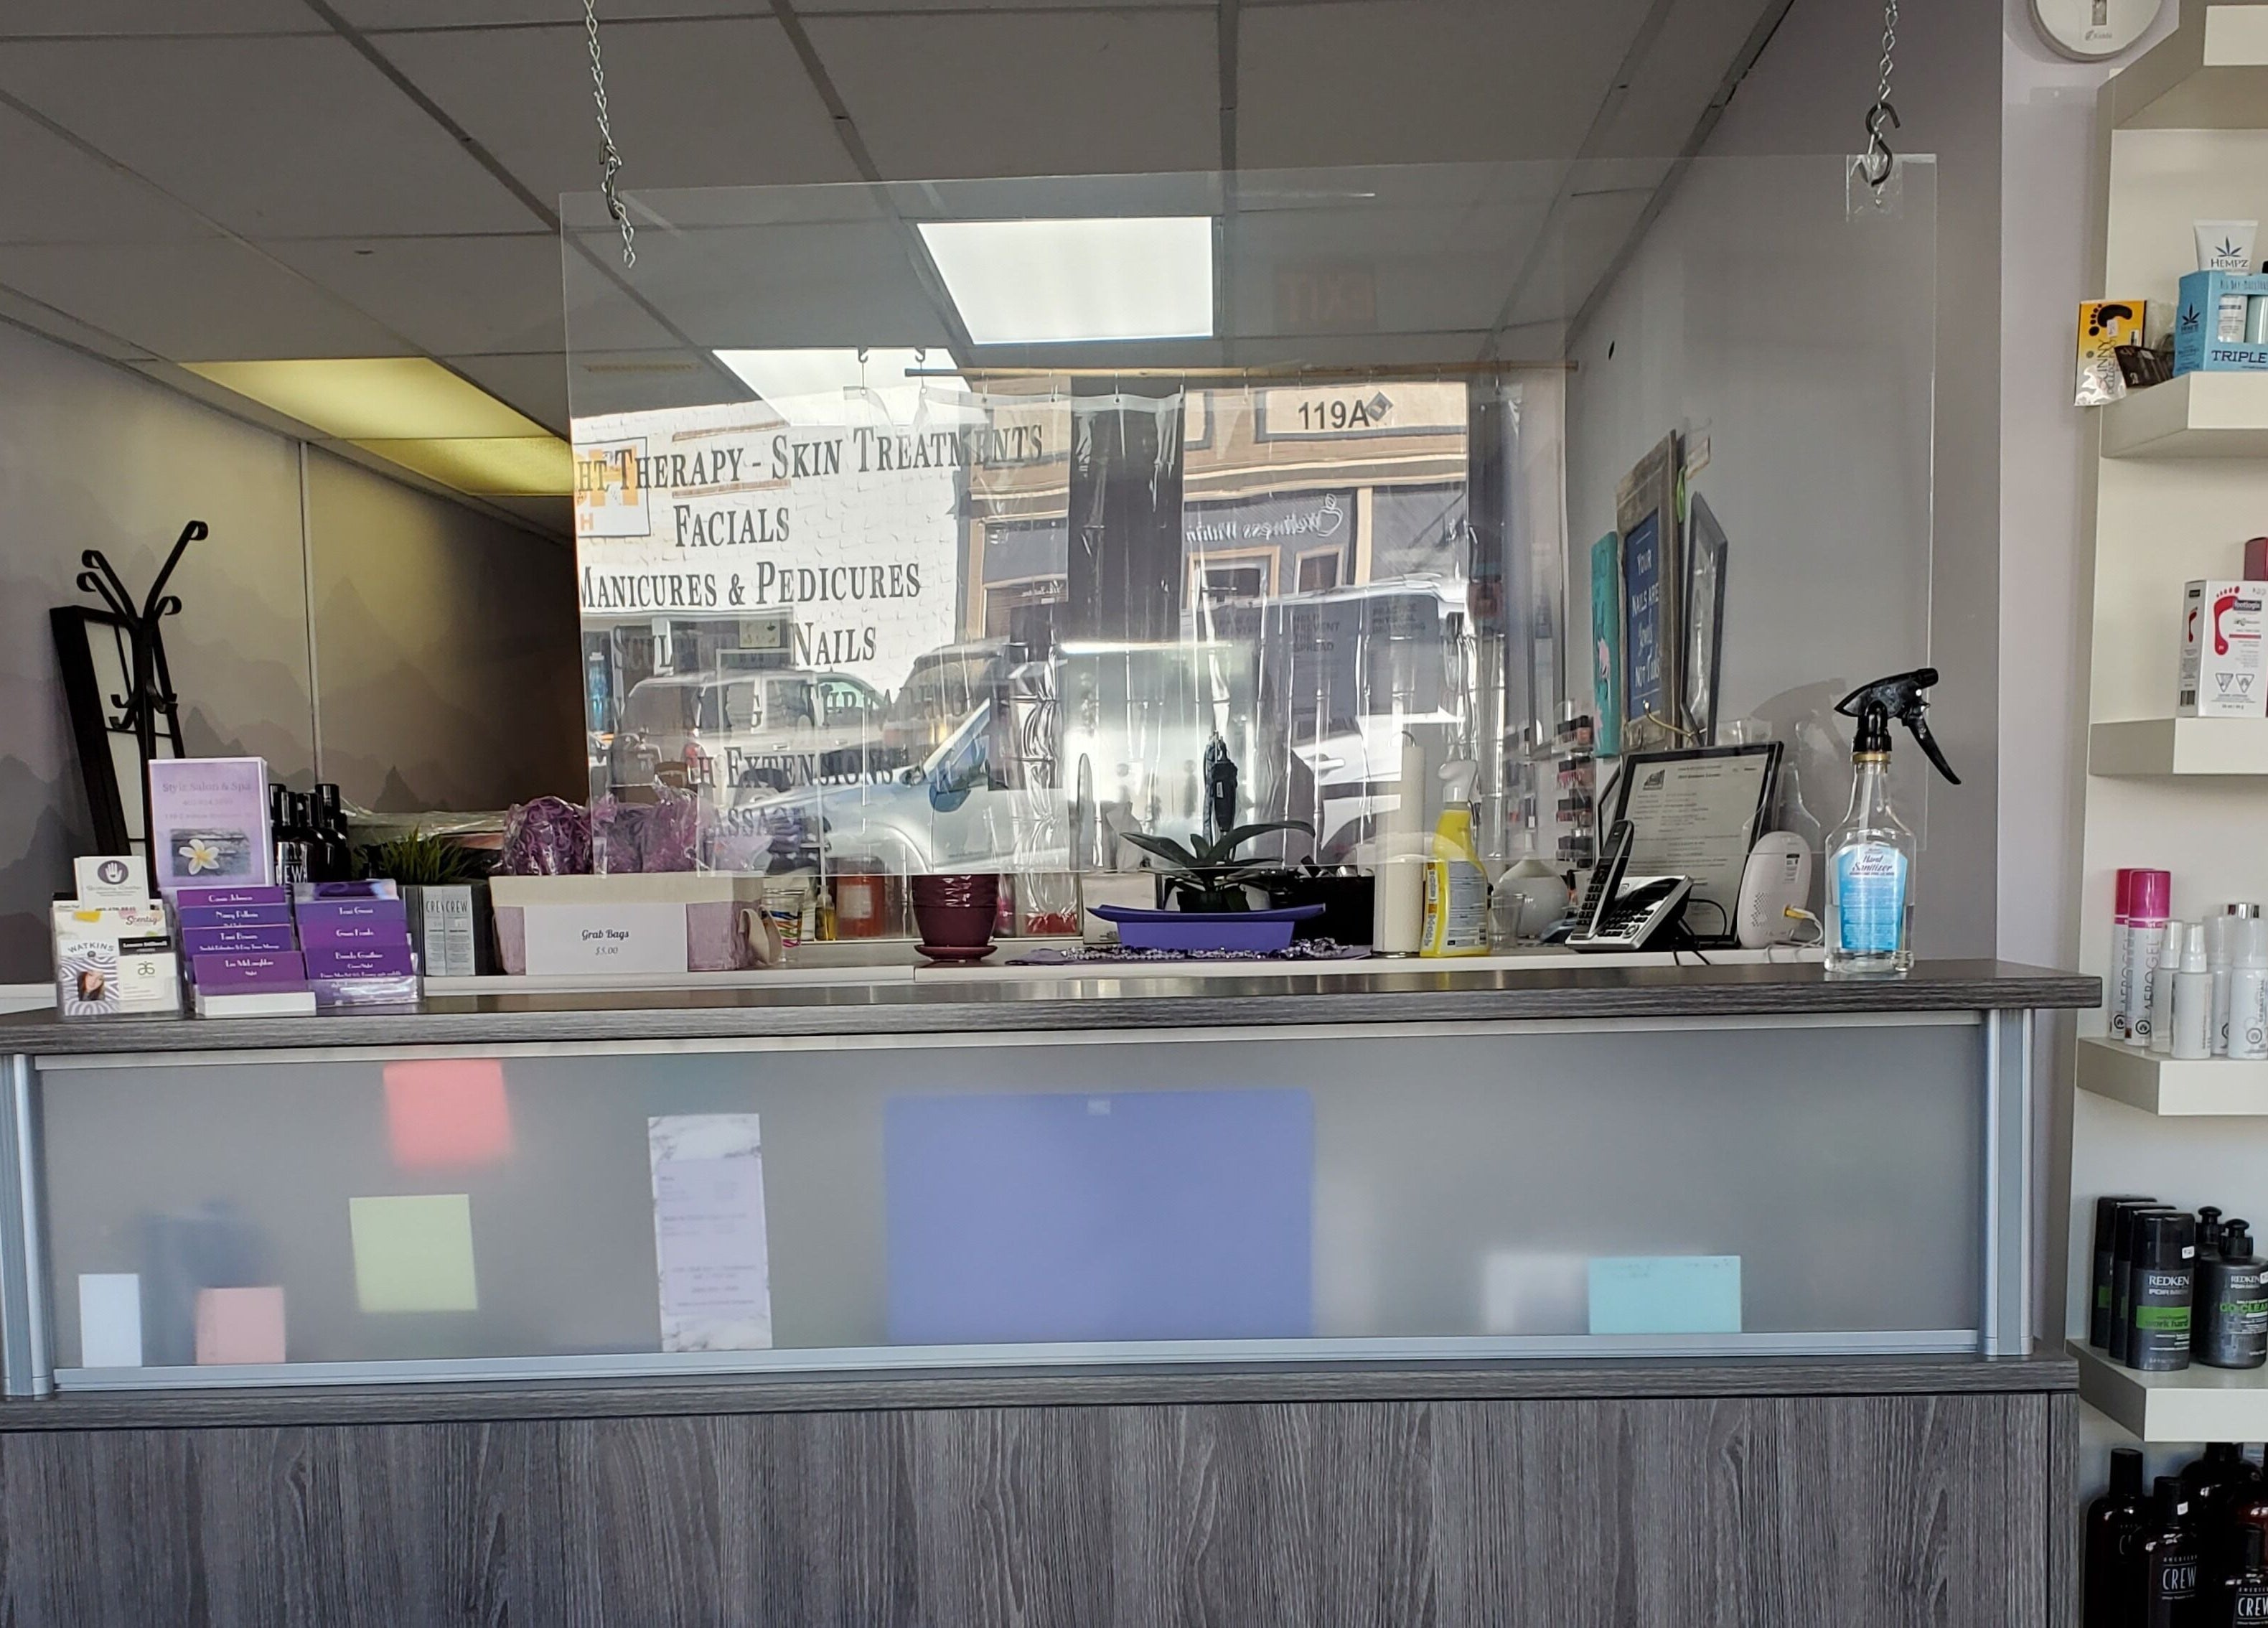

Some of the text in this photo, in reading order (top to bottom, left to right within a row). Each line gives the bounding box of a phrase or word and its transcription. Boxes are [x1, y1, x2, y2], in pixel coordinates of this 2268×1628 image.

[2211, 258, 2249, 268] HEMPZ
[2211, 350, 2267, 363] TRIPLE
[1298, 399, 1370, 431] 119A
[615, 448, 744, 490] THERAPY
[772, 435, 843, 479] SKIN
[853, 424, 1042, 472] TREATMENTS
[673, 504, 790, 547] FACIALS
[1637, 549, 1651, 575] YOUR
[580, 561, 921, 609] MANICURES & PEDICURES
[1632, 589, 1648, 617] NAILS
[790, 622, 877, 667] NAILS
[724, 747, 894, 788] EXTENSIONS
[1852, 861, 1893, 872] Sanitizer
[446, 900, 468, 913] CREW
[126, 915, 159, 926] Scentsy
[581, 929, 629, 941] Grab Bags
[67, 942, 114, 953] WATKINS
[595, 946, 618, 955] $5.00
[2149, 1275, 2189, 1286] REDKEN
[2162, 1566, 2196, 1590] CREW
